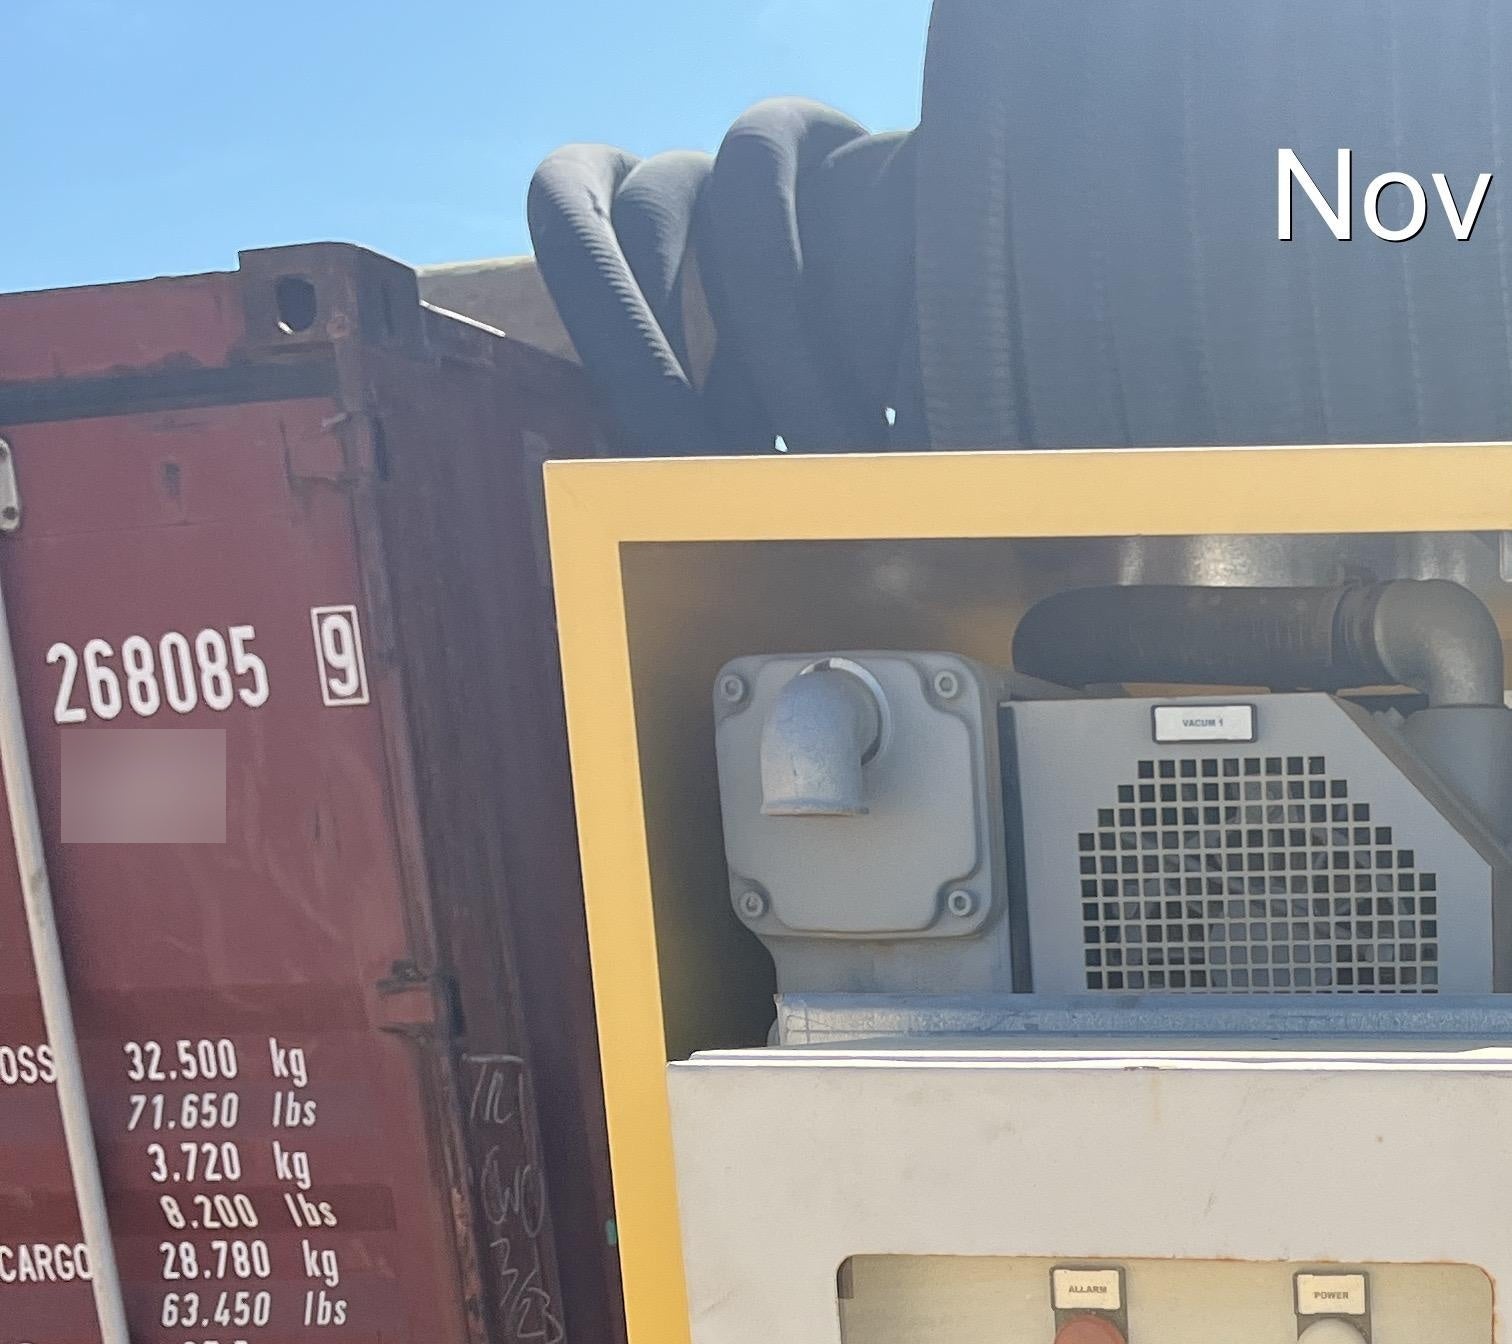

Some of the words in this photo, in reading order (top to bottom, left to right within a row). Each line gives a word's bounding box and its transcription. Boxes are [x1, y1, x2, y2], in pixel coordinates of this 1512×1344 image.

[46, 624, 269, 723] 268085
[1182, 718, 1216, 728] VACUM
[0, 1043, 57, 1085] OSS
[124, 1039, 238, 1082] 32.500
[269, 1038, 308, 1087] kg
[127, 1093, 240, 1131] 71.650
[272, 1093, 317, 1128] lbs
[147, 1141, 241, 1182] 3.720
[273, 1140, 312, 1189] kg
[160, 1193, 259, 1229] 8.200
[284, 1192, 338, 1228] lbs
[0, 1242, 93, 1283] CARGO
[159, 1239, 271, 1281] 28.780
[301, 1239, 339, 1287] kg
[161, 1291, 271, 1328] 63.450
[304, 1290, 347, 1326] lbs
[1314, 1289, 1349, 1300] POWER
